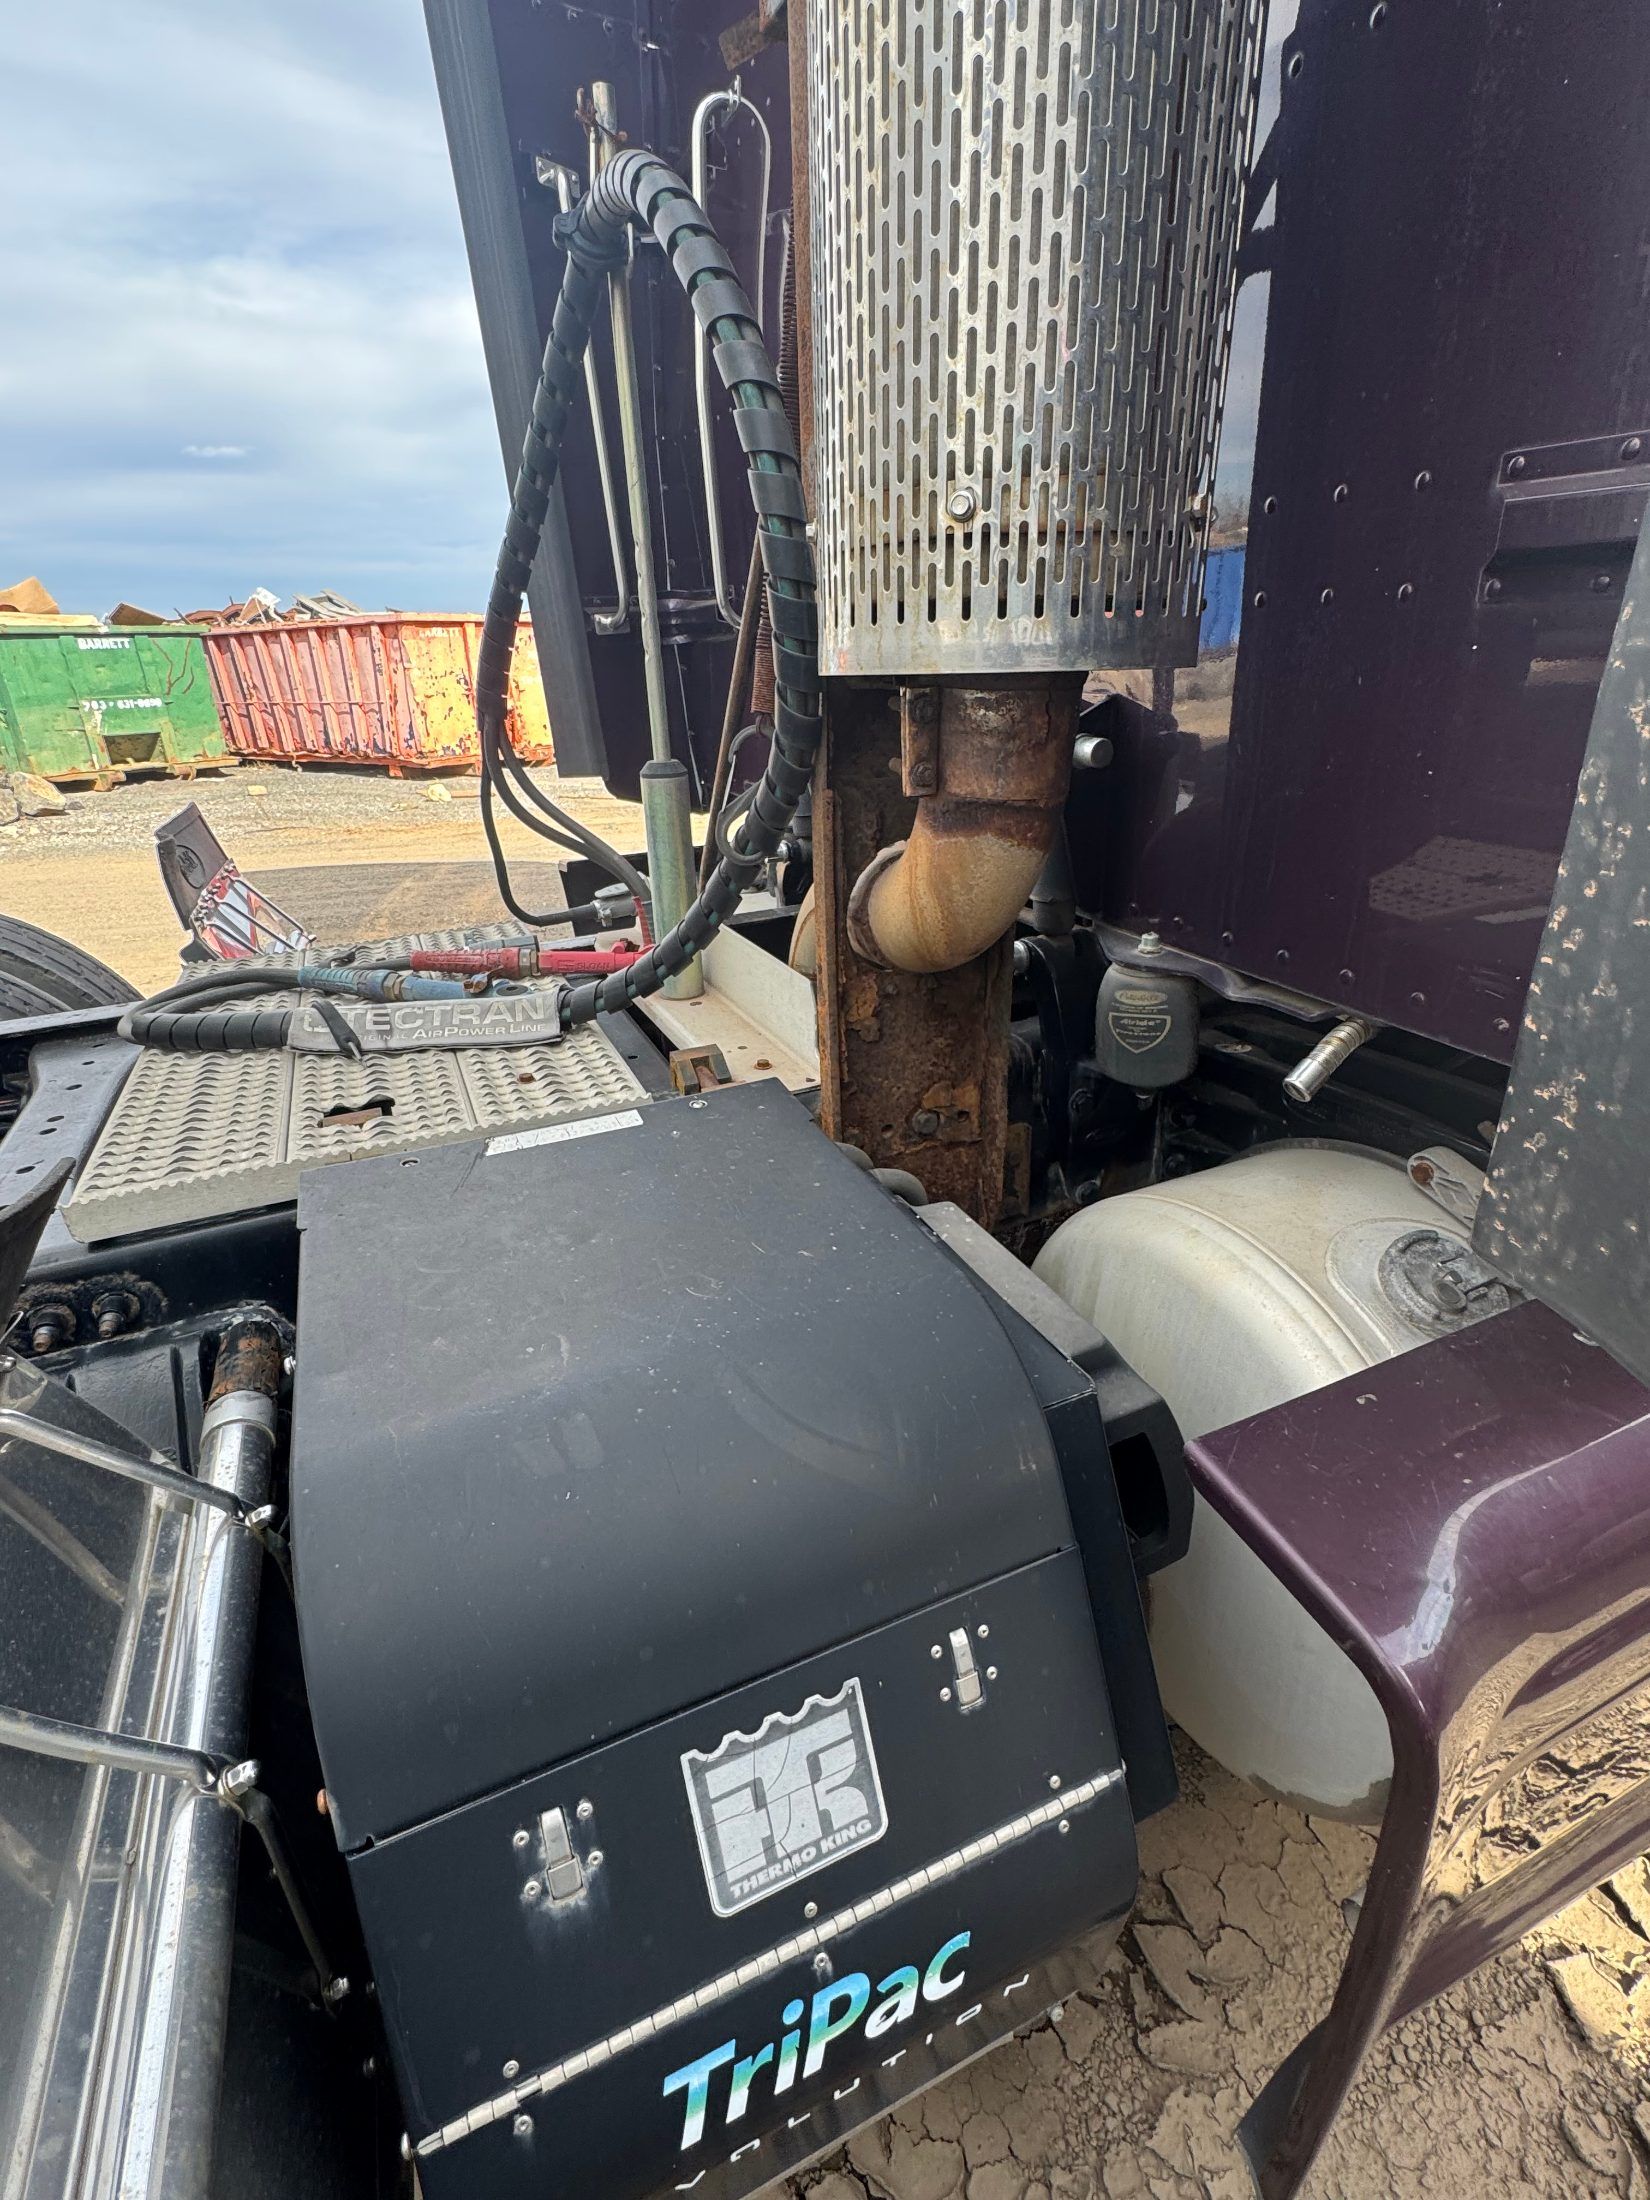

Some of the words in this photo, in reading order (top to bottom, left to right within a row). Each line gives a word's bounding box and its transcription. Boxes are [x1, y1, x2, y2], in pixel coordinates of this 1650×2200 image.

[341, 997, 546, 1031] TECTRAN
[730, 1846, 817, 1898] THERMO
[820, 1818, 872, 1855] KING
[662, 1930, 972, 2151] TriPac
